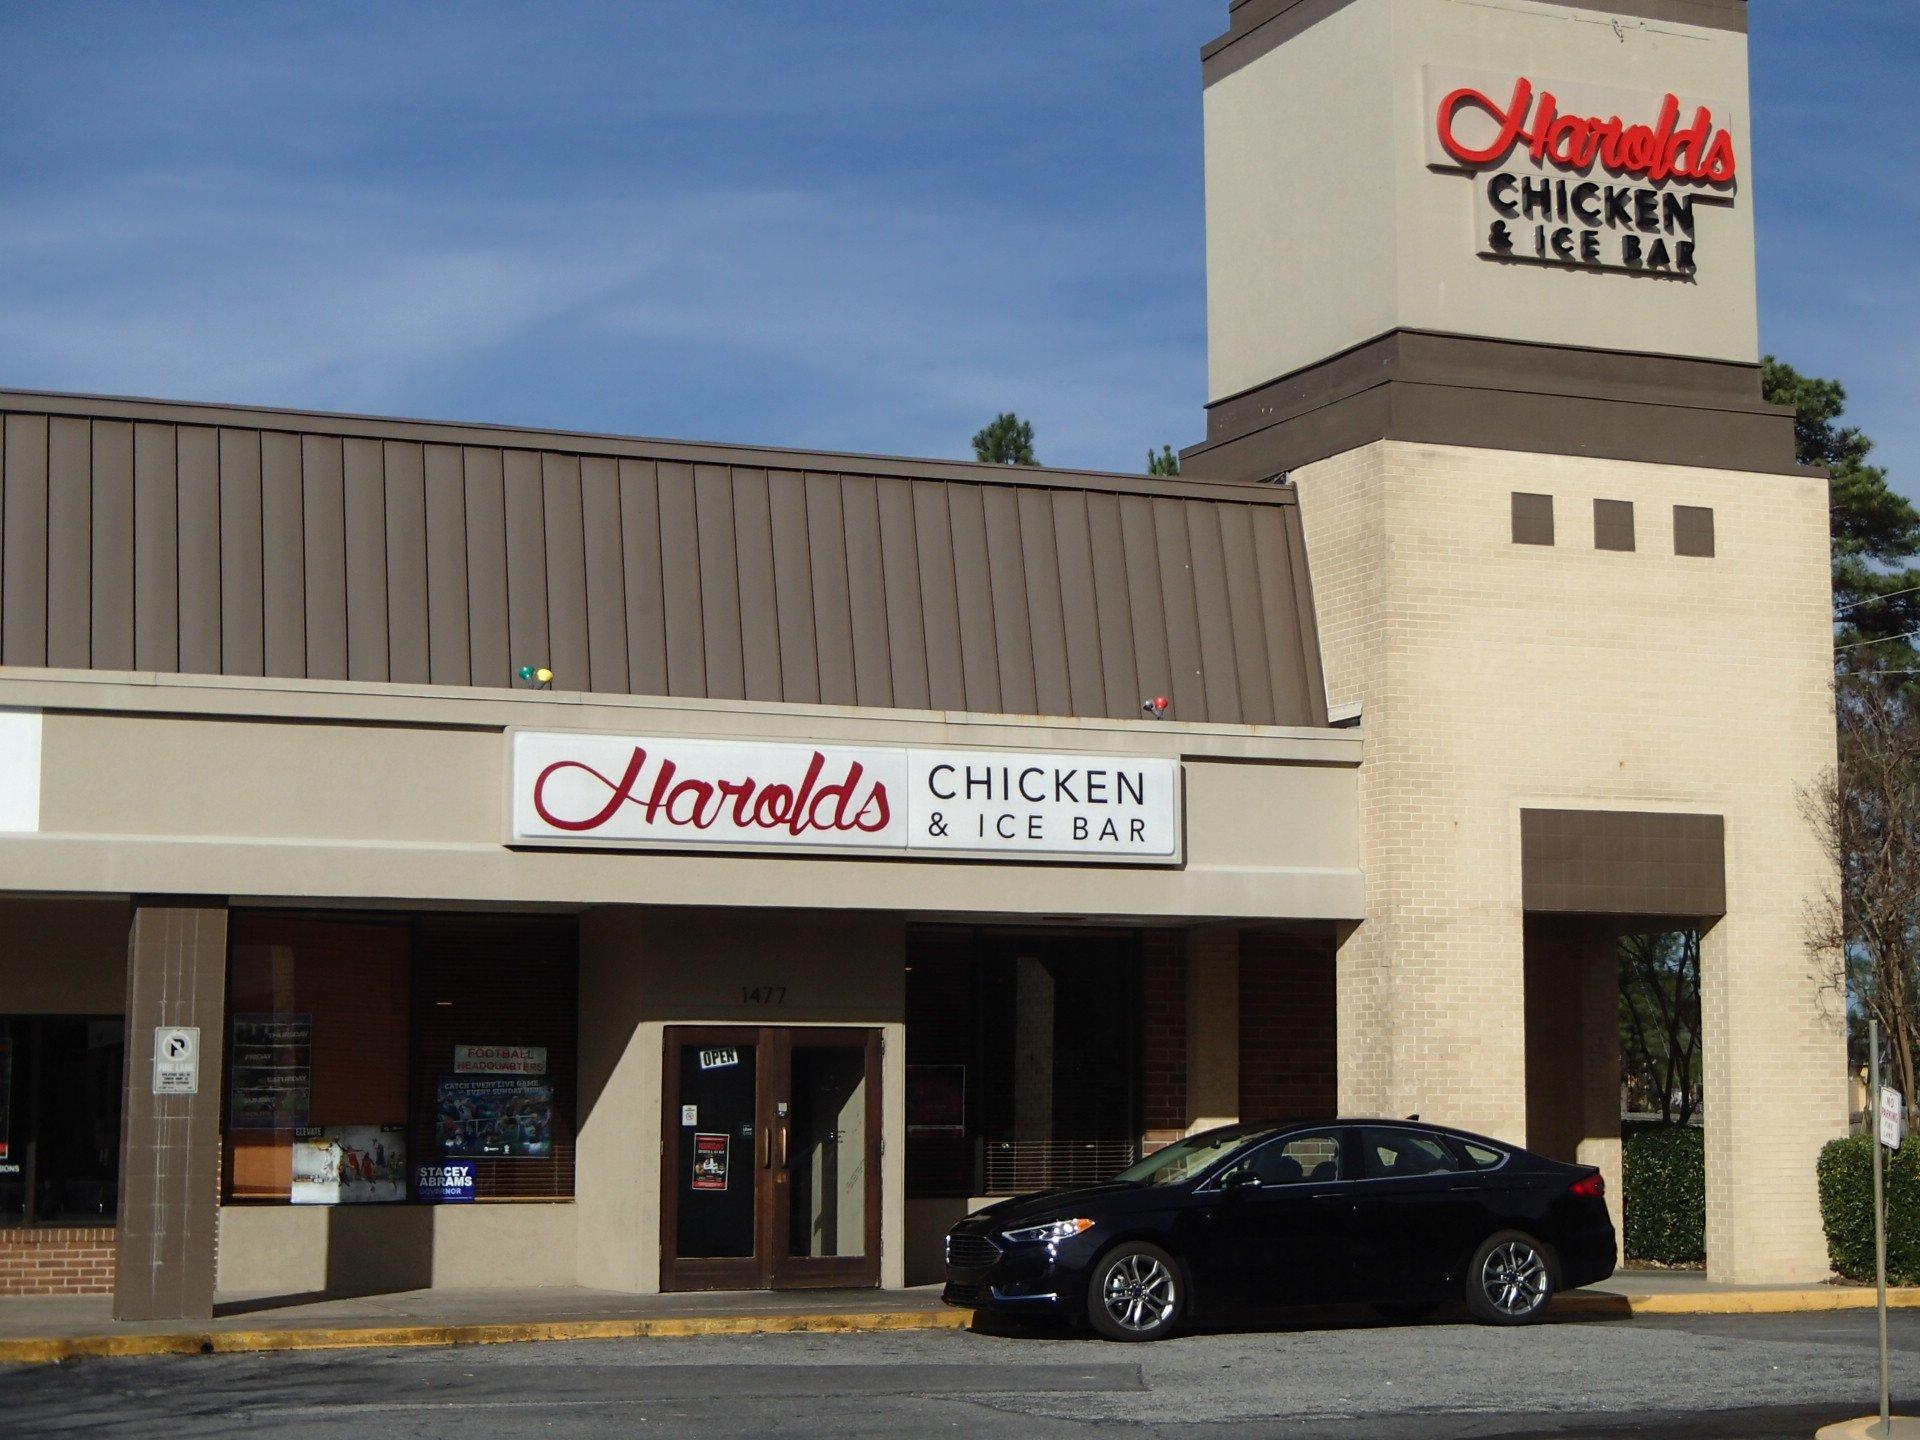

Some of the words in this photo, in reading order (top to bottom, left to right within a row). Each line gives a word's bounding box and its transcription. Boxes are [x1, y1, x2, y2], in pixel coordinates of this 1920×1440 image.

[1436, 76, 1736, 182] Harolds
[1487, 172, 1694, 234] CHICKEN
[1488, 219, 1514, 255] &
[1534, 225, 1601, 261] ICE
[1621, 234, 1696, 270] BAR
[534, 746, 892, 836] Harolds
[928, 764, 1145, 806] CHICKEN
[928, 812, 950, 838] &
[978, 813, 1044, 840] ICE
[1073, 817, 1147, 844] BAR
[742, 986, 787, 1004] 1477
[468, 1048, 535, 1060] FOOTBALL
[703, 1049, 735, 1067] OPEN
[456, 1061, 545, 1072] HEADQUARTERS
[295, 1127, 323, 1137] ELEVATE
[419, 1166, 469, 1177] STACEY
[419, 1176, 473, 1187] ABRAMS
